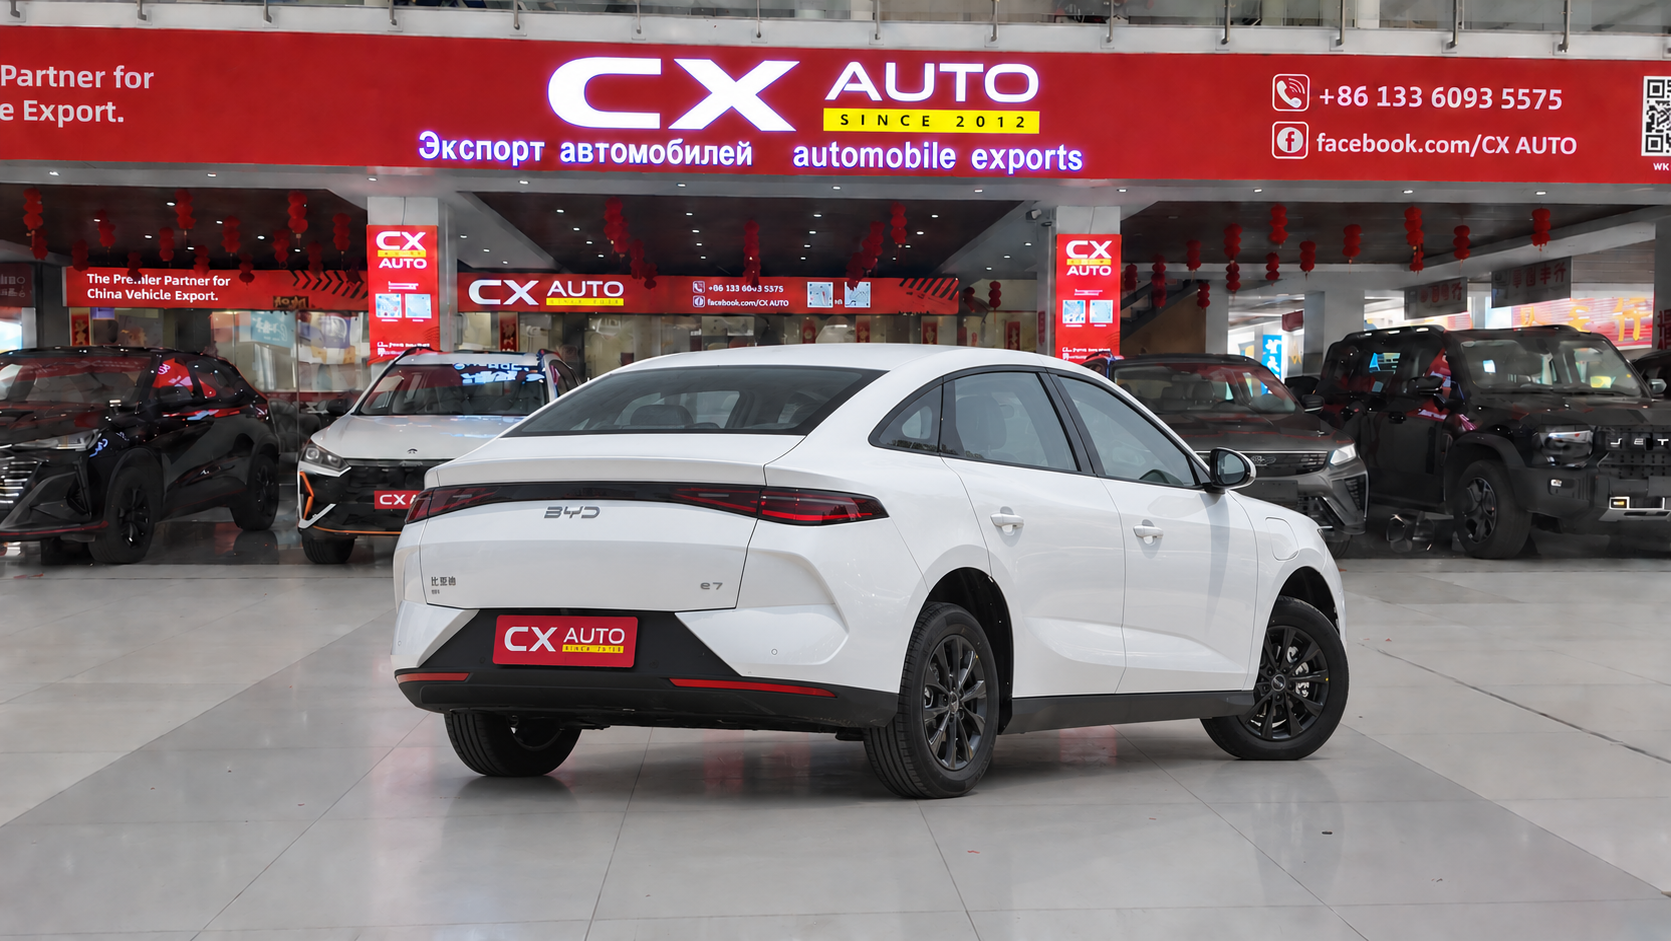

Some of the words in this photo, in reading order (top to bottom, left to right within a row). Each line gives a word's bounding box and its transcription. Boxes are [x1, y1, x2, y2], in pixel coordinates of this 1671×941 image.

[0, 65, 106, 88] Partner
[113, 65, 155, 89] for
[547, 56, 800, 132] CX
[824, 61, 1039, 103] AUTO
[1319, 85, 1368, 107] +86
[1376, 86, 1423, 108] 133
[1431, 87, 1493, 109] 6093
[1501, 89, 1563, 111] 5575
[23, 100, 125, 128] Export.
[840, 114, 931, 127] SINCE
[956, 115, 1025, 128] 2012
[418, 130, 545, 167] Экспорт
[559, 138, 753, 166] автомобилей
[1316, 133, 1510, 157] facebook.com/CX
[1515, 136, 1578, 155] AUTO
[792, 141, 956, 169] automobile
[970, 144, 1083, 175] exports
[376, 231, 427, 250] CX
[1066, 240, 1113, 259] CX
[379, 258, 427, 269] AUTO
[1067, 265, 1112, 276] AUTO
[87, 273, 110, 284] The
[164, 275, 209, 286] Partner
[212, 276, 231, 287] for
[87, 288, 123, 300] China
[125, 288, 171, 300] Vehicle
[175, 290, 219, 303] Export.
[468, 279, 540, 306] CX
[547, 280, 624, 297] AUTO
[379, 494, 406, 506] CX
[544, 506, 601, 519] BYD
[700, 582, 723, 590] e7
[504, 626, 558, 652] CX
[563, 627, 625, 644] AUTO
